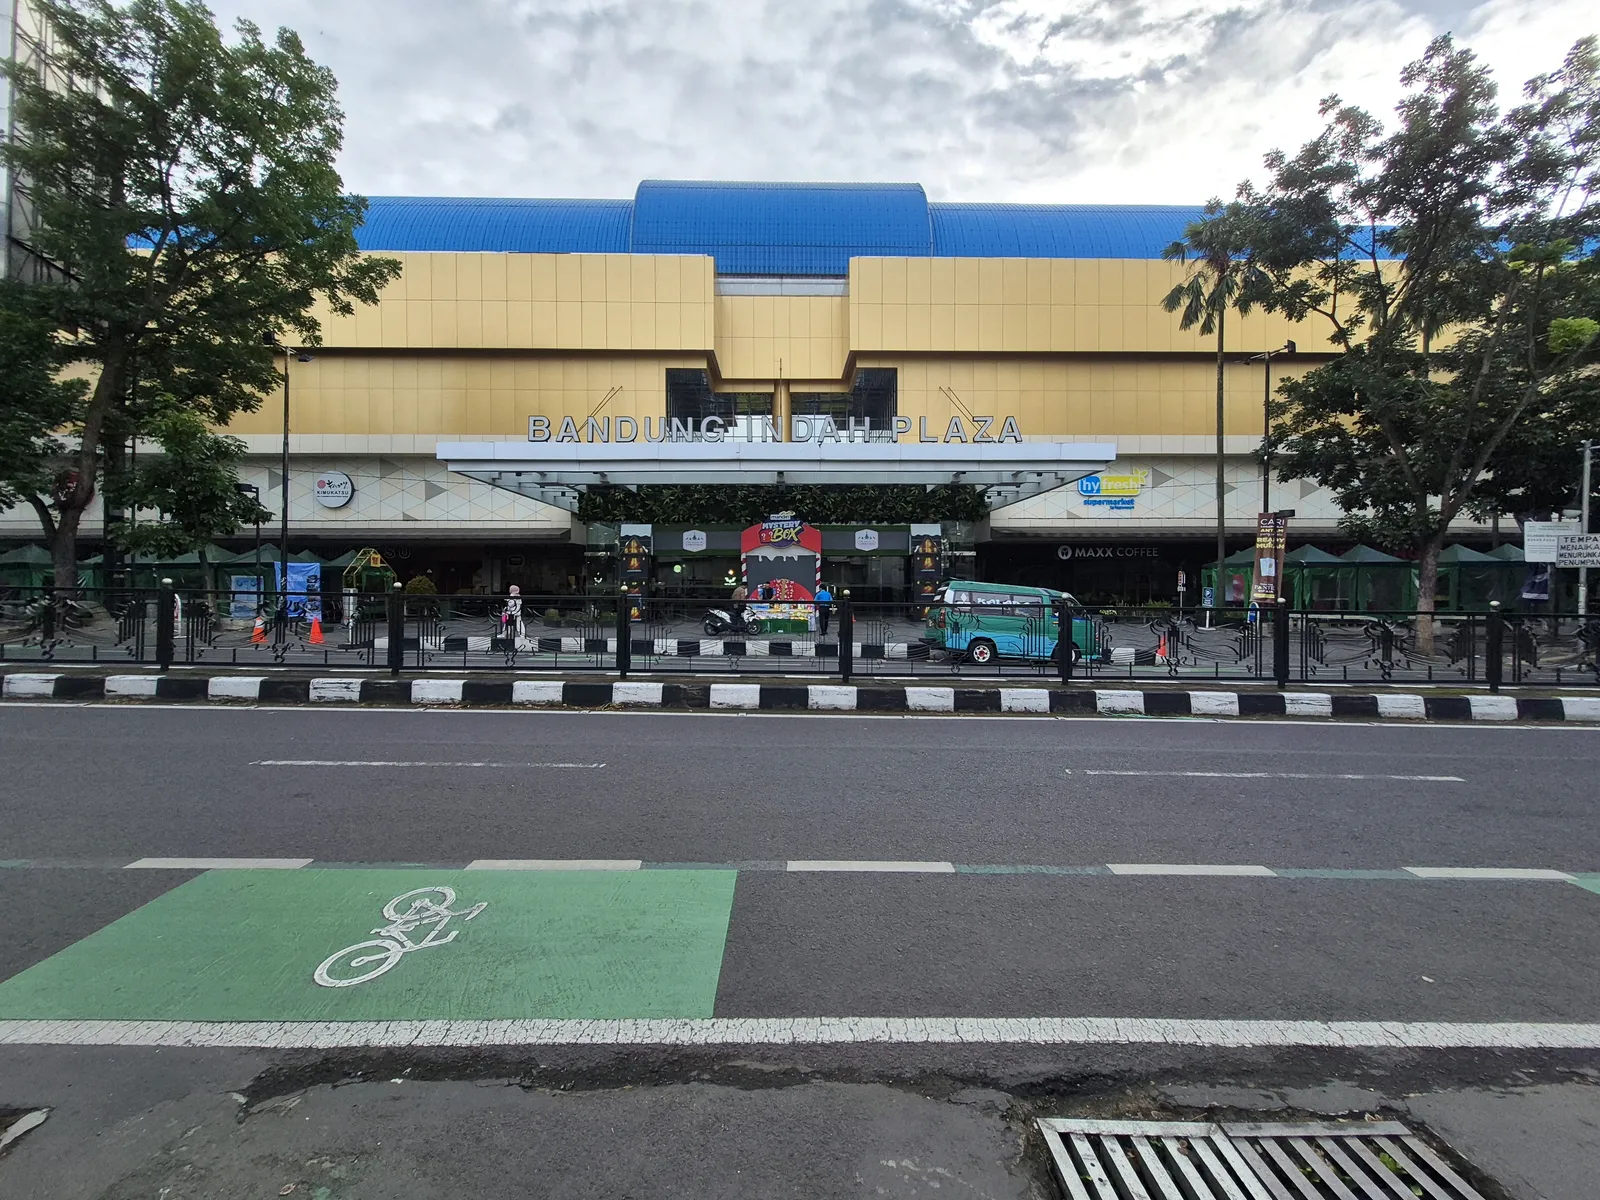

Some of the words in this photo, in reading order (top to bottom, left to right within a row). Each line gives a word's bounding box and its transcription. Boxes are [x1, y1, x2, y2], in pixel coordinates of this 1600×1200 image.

[527, 415, 726, 443] BANDUNG
[735, 415, 872, 443] INDAH
[890, 415, 1024, 443] PLAZA
[1083, 498, 1135, 506] supermarket
[762, 520, 801, 530] MYSTERY
[1260, 518, 1285, 526] CARI
[770, 526, 802, 543] BOX
[1564, 535, 1600, 543] TEMPA
[1074, 547, 1113, 557] MAXX
[1116, 547, 1159, 556] COFFEE
